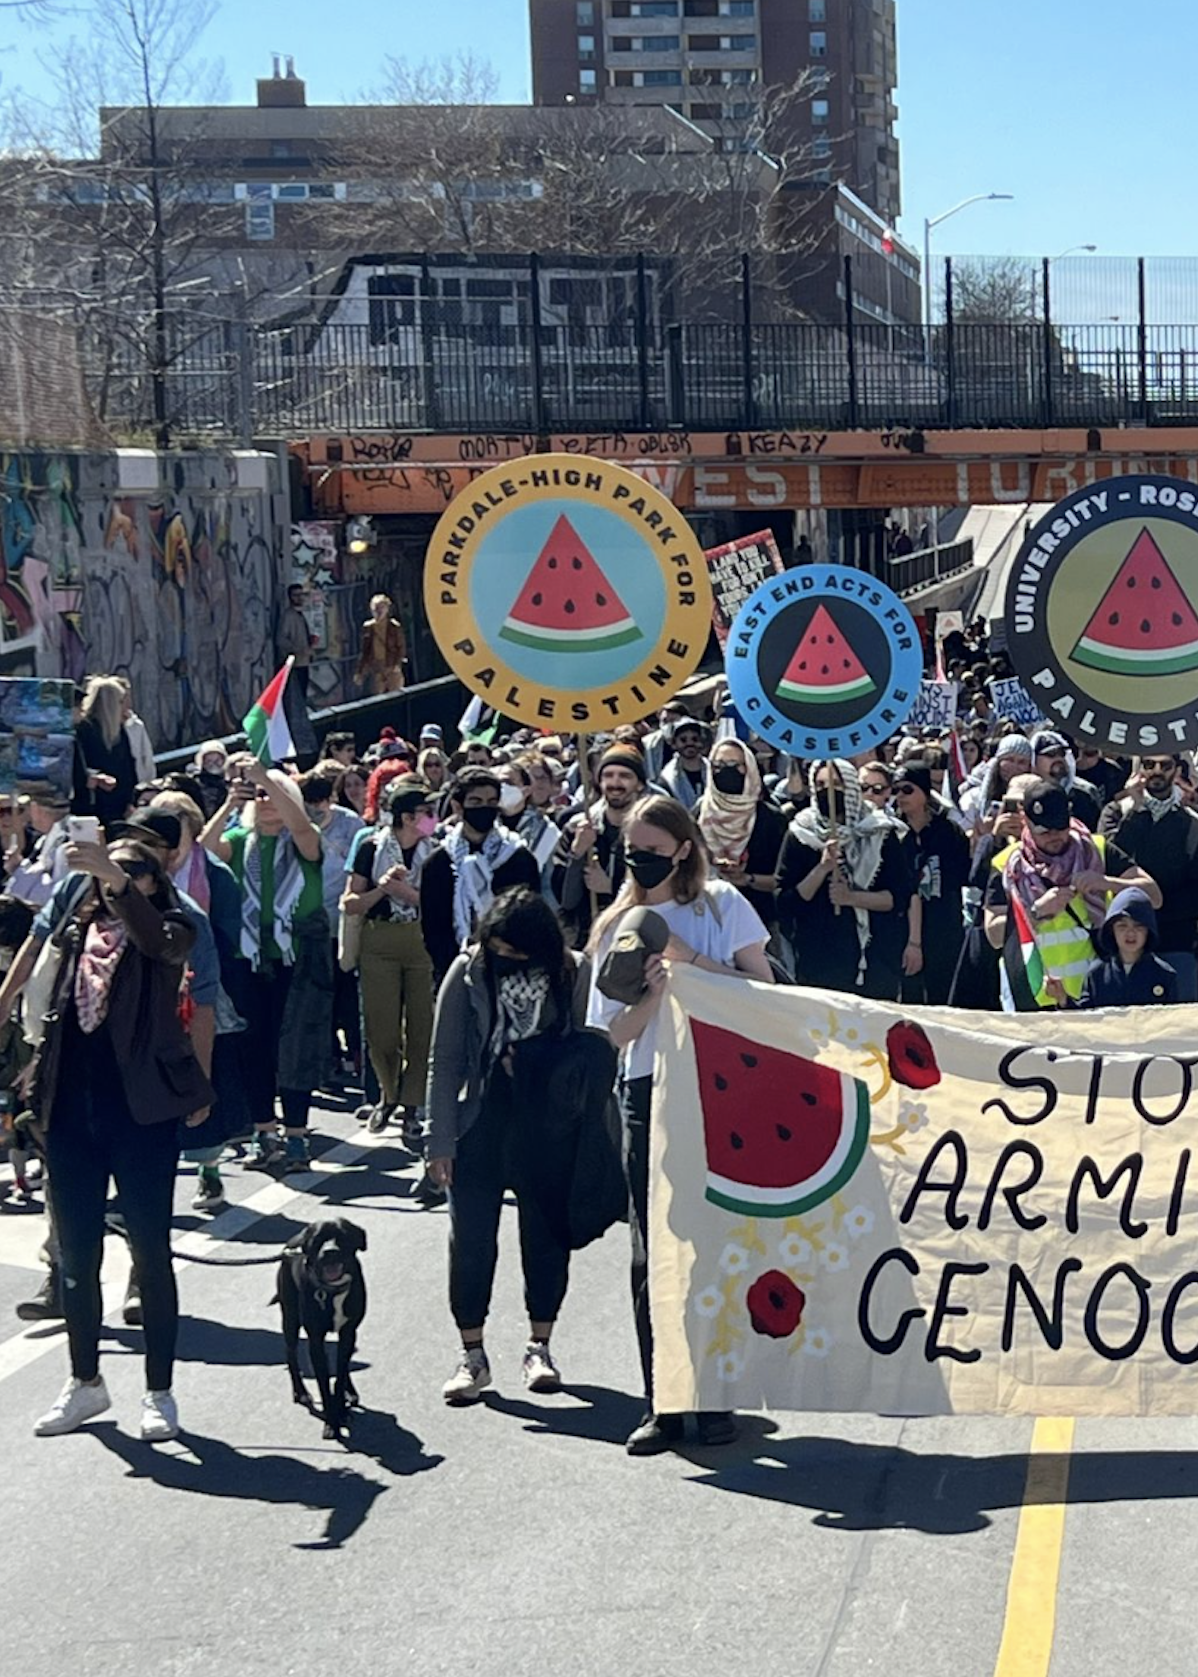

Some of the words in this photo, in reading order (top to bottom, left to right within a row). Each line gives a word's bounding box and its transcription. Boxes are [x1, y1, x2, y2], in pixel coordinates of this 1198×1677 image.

[441, 468, 603, 605] PARKDALE-HIGH
[612, 484, 678, 546] PARK
[671, 553, 695, 607] FOR
[1015, 491, 1108, 633] UNIVERSITY
[734, 602, 767, 659] EAST
[770, 576, 814, 603] END
[825, 574, 883, 605] ACTS
[884, 607, 912, 651] FOR
[453, 638, 689, 721] PALESTINE
[746, 689, 908, 752] CEASEFIRE
[901, 710, 952, 727] NOCIDE
